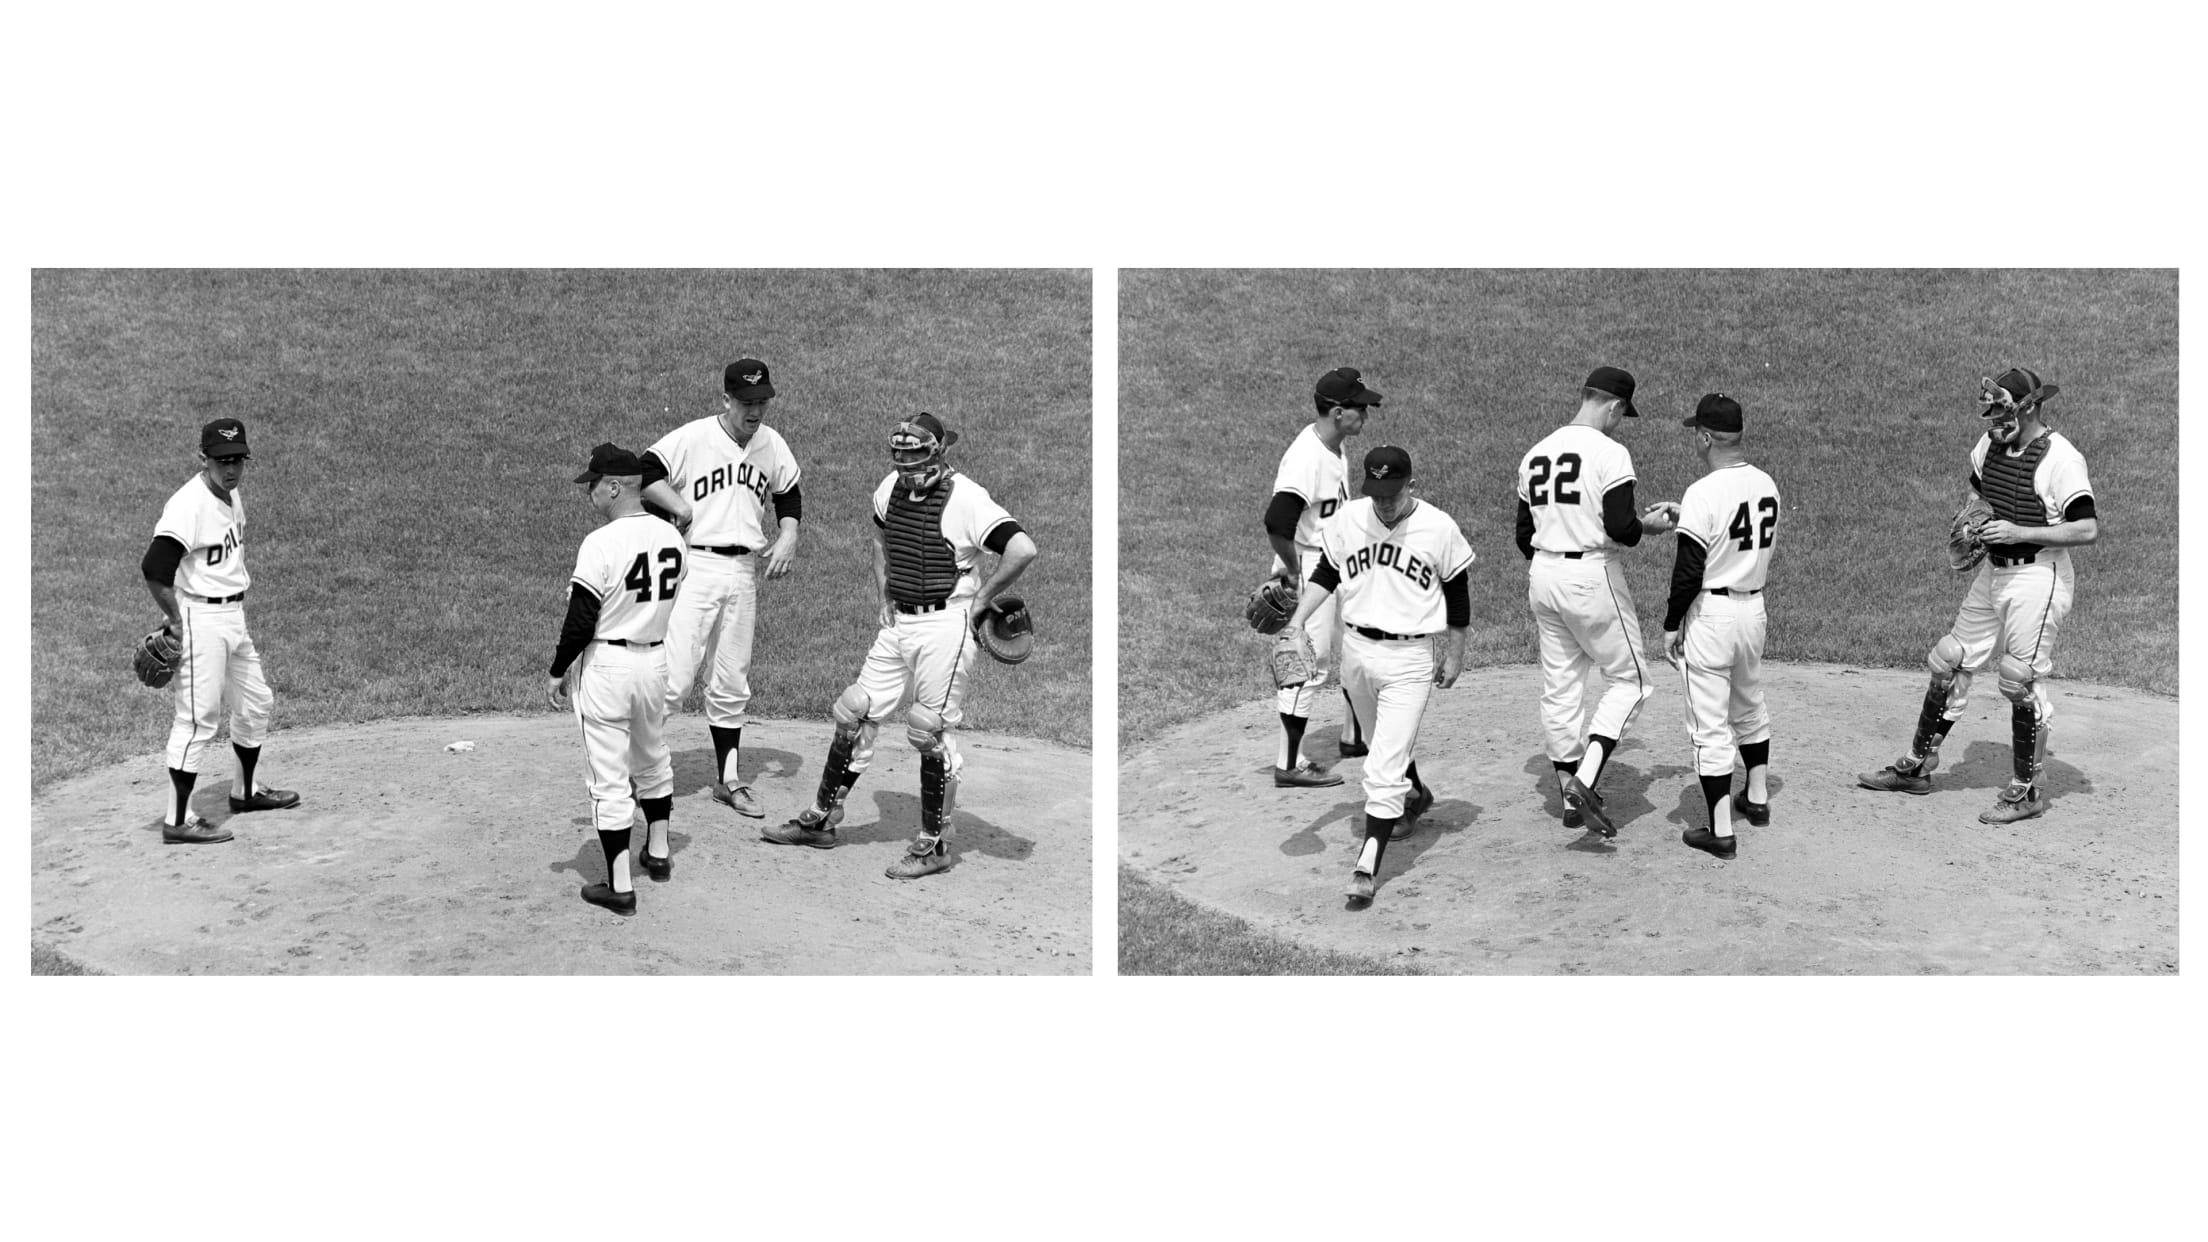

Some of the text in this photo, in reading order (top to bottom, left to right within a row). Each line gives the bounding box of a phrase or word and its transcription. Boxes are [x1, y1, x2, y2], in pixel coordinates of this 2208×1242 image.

[1529, 453, 1582, 507] 22
[1729, 496, 1778, 552] 42
[624, 547, 682, 603] 42
[1346, 542, 1433, 590] ORIOLES
